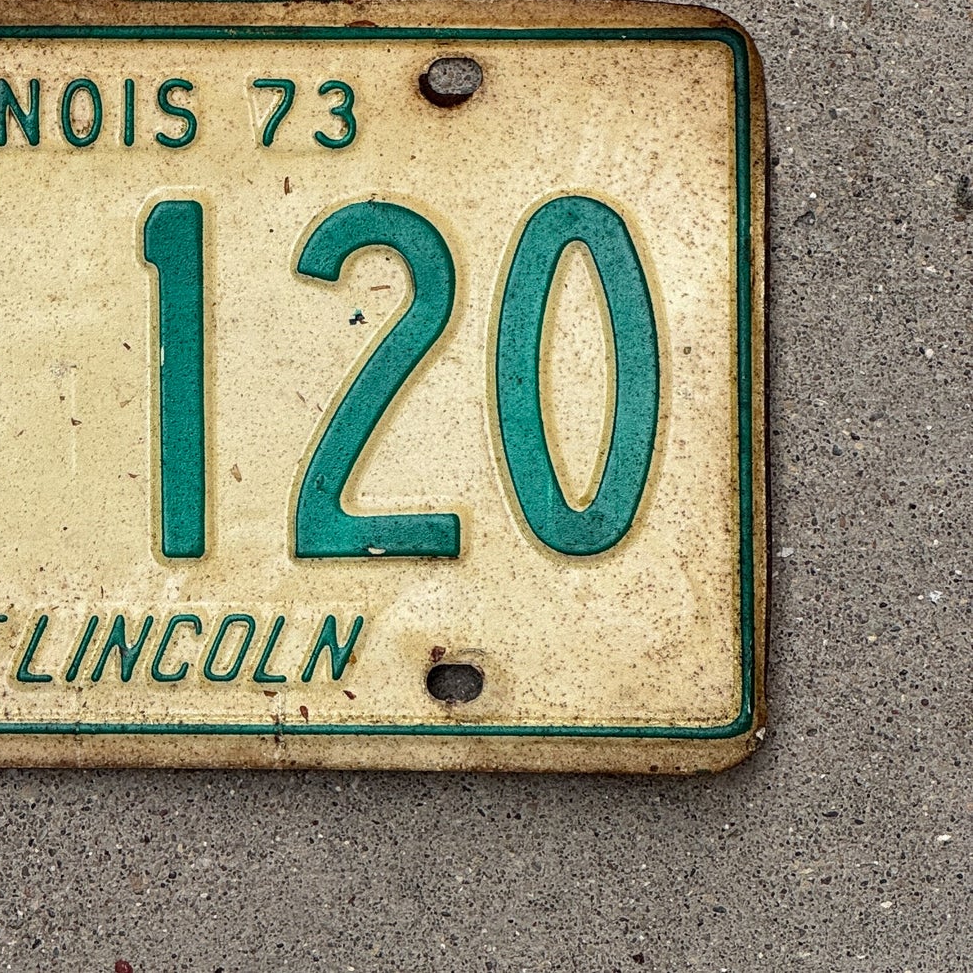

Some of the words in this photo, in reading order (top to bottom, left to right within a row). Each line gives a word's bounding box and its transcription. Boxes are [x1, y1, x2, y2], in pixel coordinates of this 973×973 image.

[254, 79, 357, 149] 73
[143, 196, 660, 558] 120
[17, 613, 364, 683] LINCOLN
